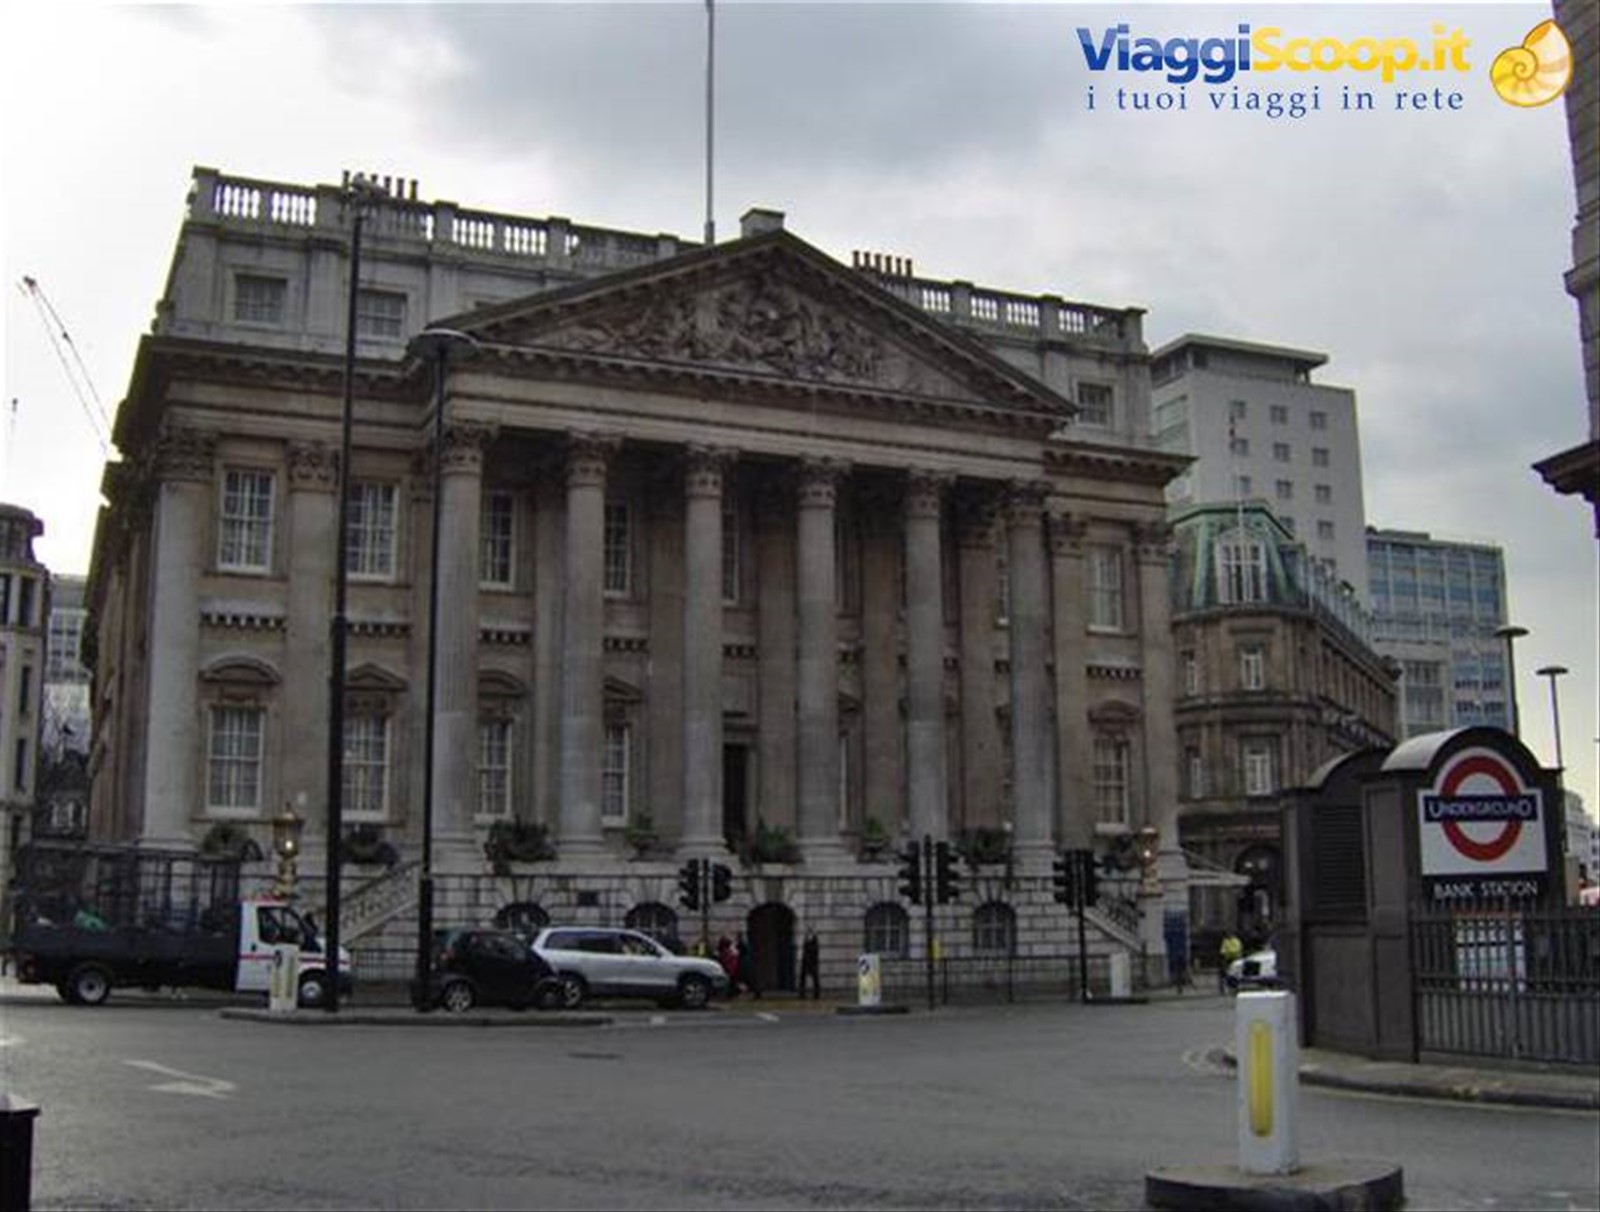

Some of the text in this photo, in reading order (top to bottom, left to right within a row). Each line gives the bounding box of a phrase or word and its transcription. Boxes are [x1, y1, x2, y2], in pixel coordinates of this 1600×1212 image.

[1428, 799, 1532, 818] UNDERGROUND
[1433, 880, 1538, 899] BANK STATION
